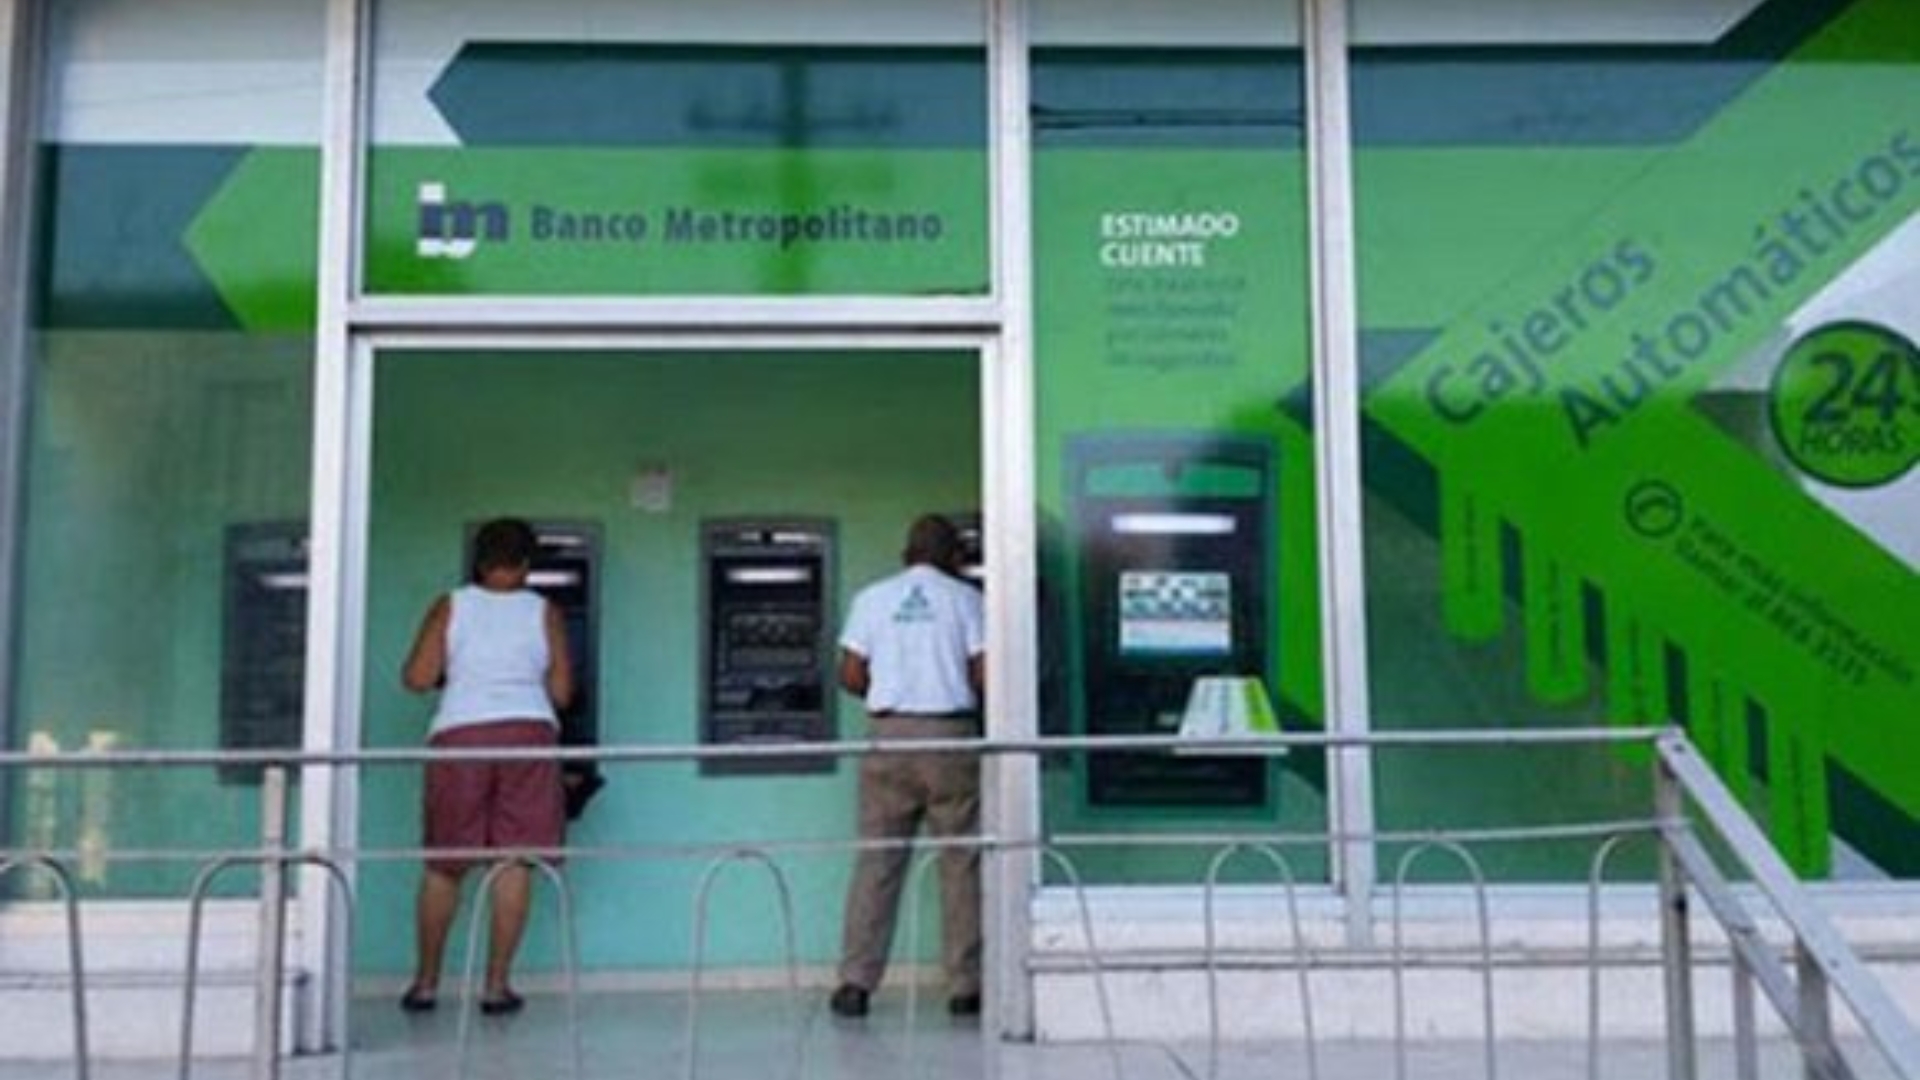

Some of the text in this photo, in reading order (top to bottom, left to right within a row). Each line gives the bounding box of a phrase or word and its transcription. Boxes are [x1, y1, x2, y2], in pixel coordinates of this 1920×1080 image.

[530, 203, 943, 248] Banco Metropolitano
[1101, 213, 1240, 237] ESTIMADO
[1556, 130, 1920, 450] Automáticos
[1425, 236, 1656, 426] Cajeros
[1804, 350, 1902, 422] 24
[1800, 425, 1904, 455] HORAS
